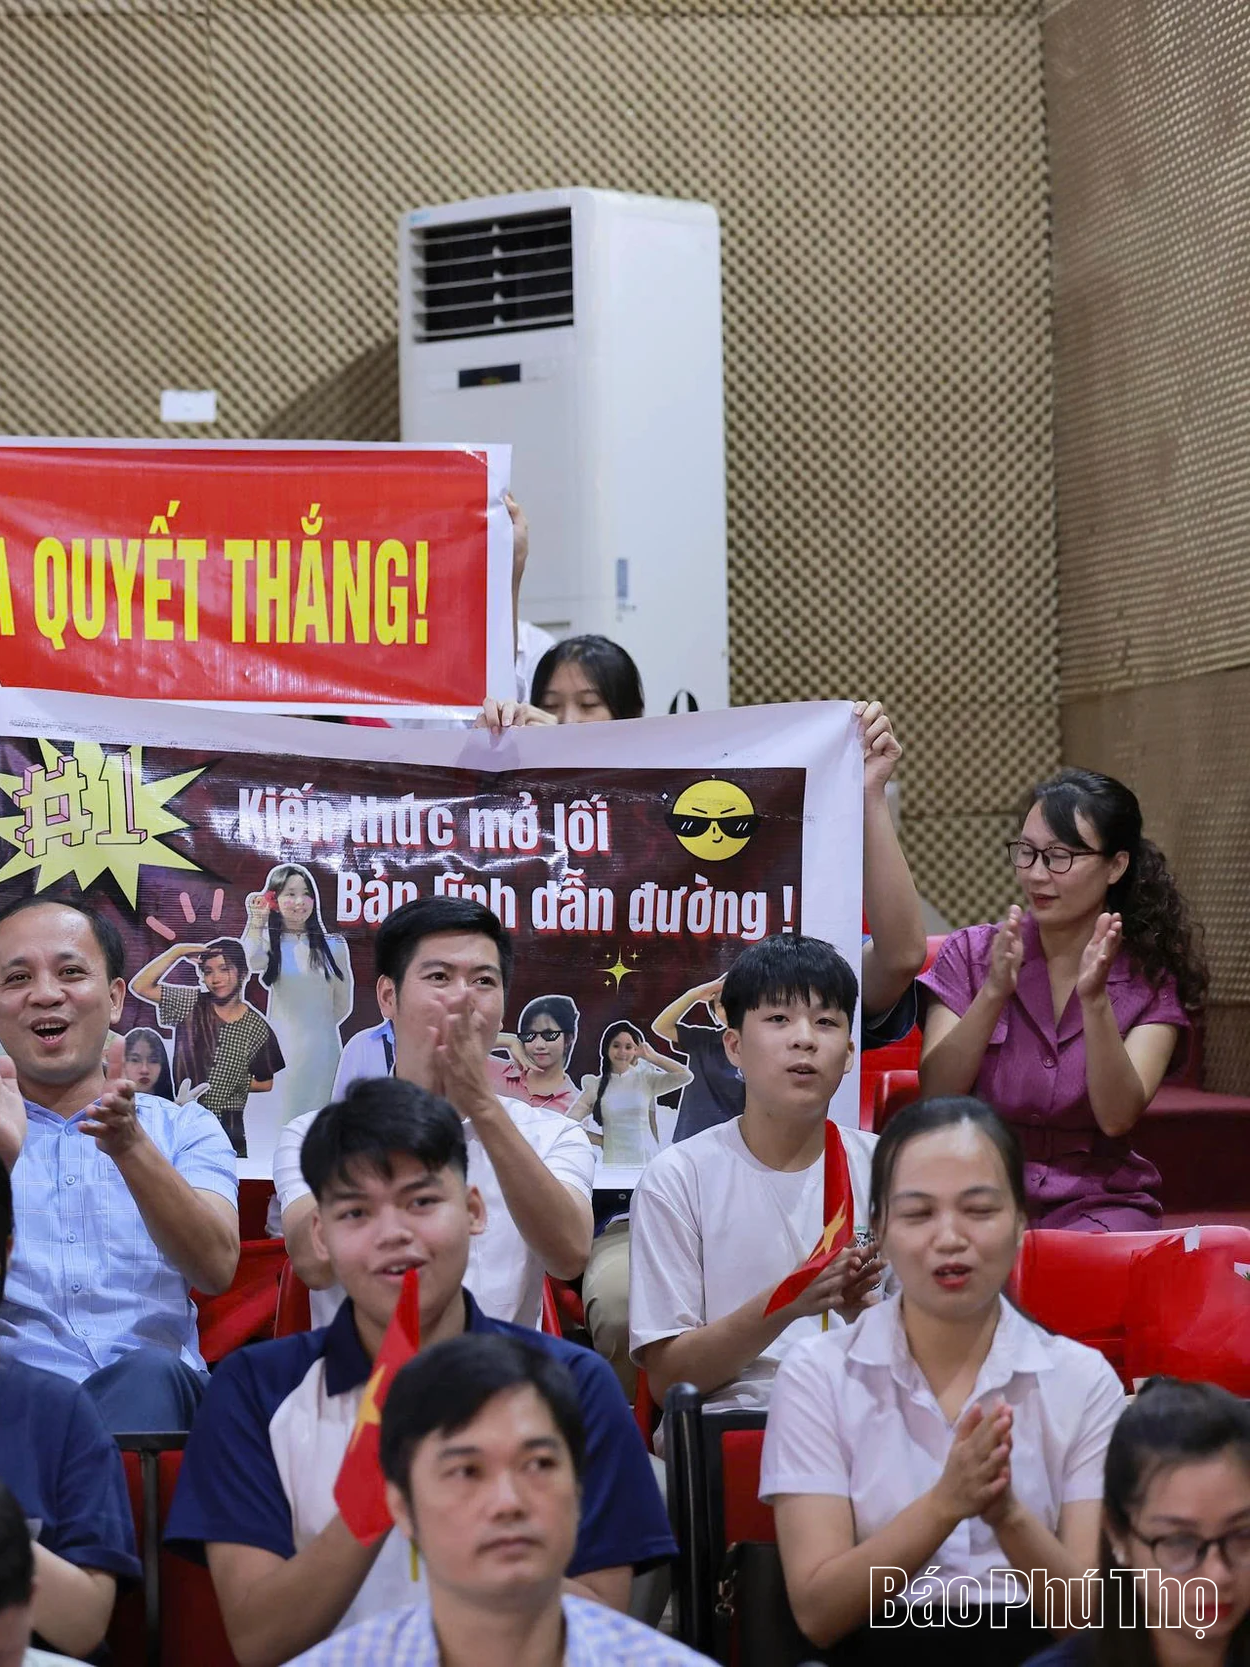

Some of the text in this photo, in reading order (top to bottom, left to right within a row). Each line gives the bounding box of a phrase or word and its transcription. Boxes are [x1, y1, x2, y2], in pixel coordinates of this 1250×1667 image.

[33, 500, 207, 651] QUYẾT
[224, 502, 430, 645] THẮNG!
[12, 751, 148, 859] #1
[238, 782, 609, 853] Kiến thức mở lối
[531, 867, 615, 932] dẫn
[628, 874, 768, 941] đường
